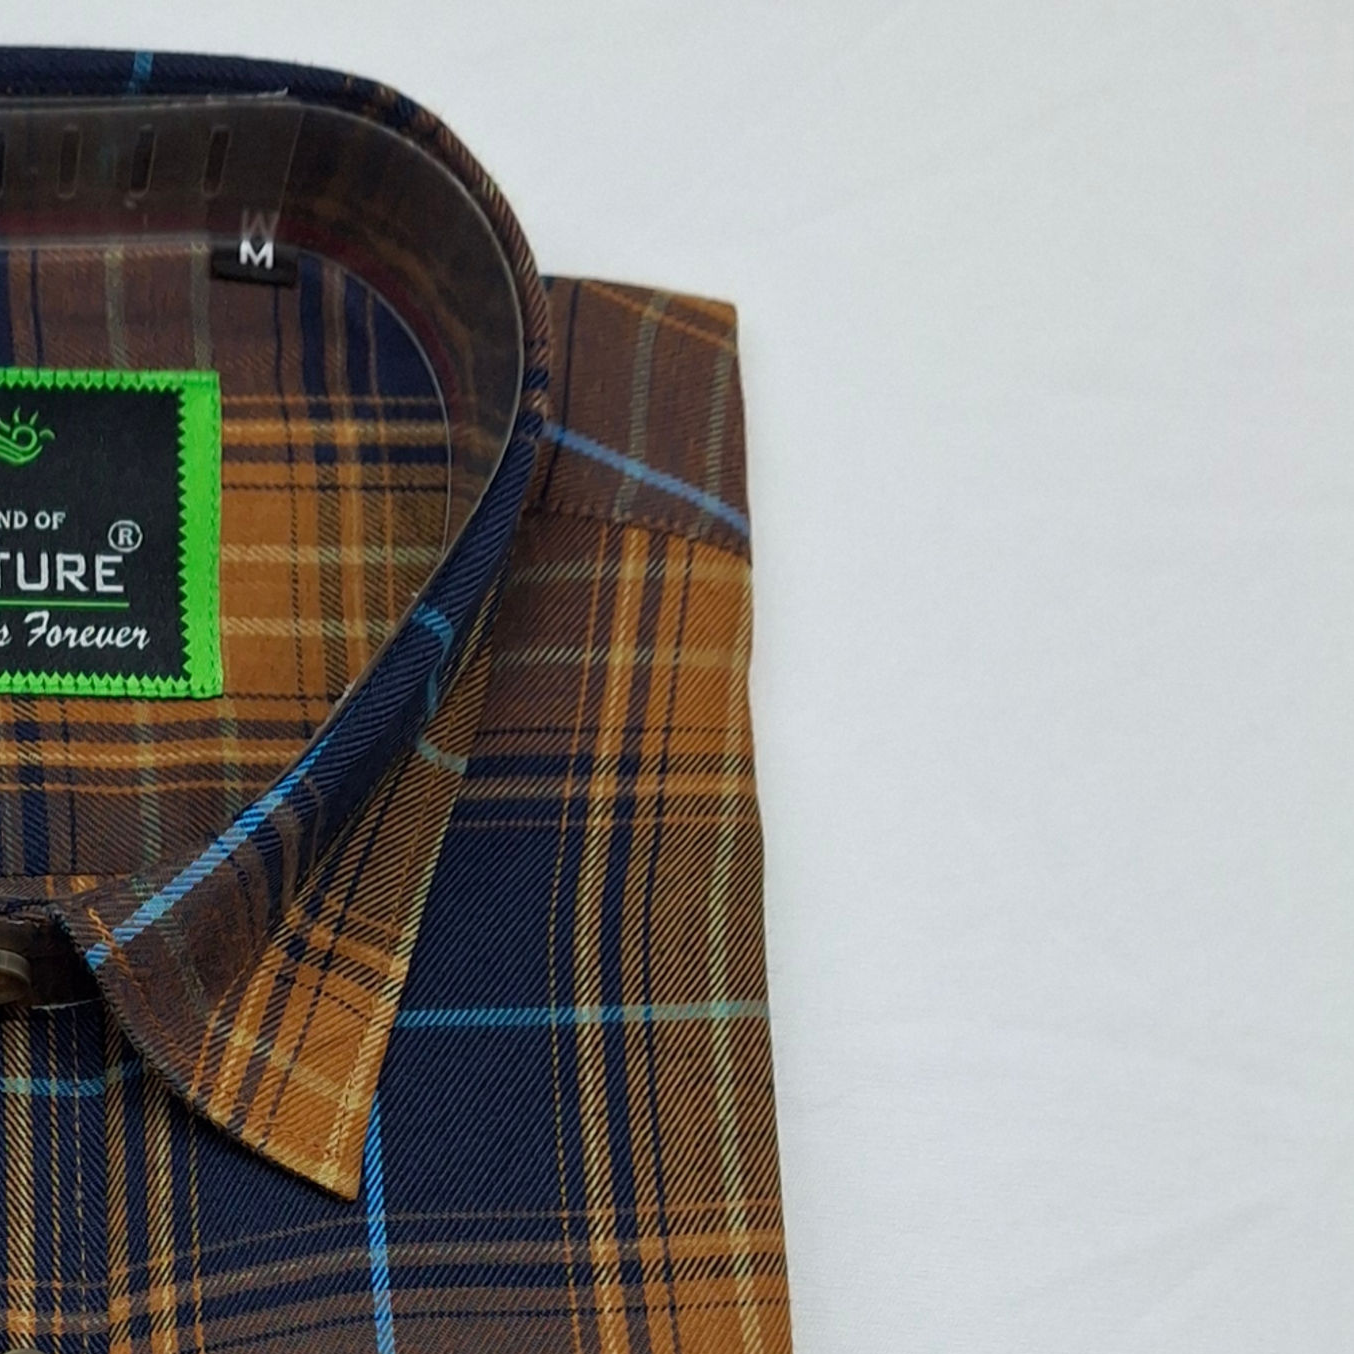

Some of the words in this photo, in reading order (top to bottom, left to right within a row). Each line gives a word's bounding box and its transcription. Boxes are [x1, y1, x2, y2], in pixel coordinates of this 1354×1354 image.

[239, 239, 275, 270] M
[33, 509, 67, 531] OF
[23, 609, 151, 650] Forever
